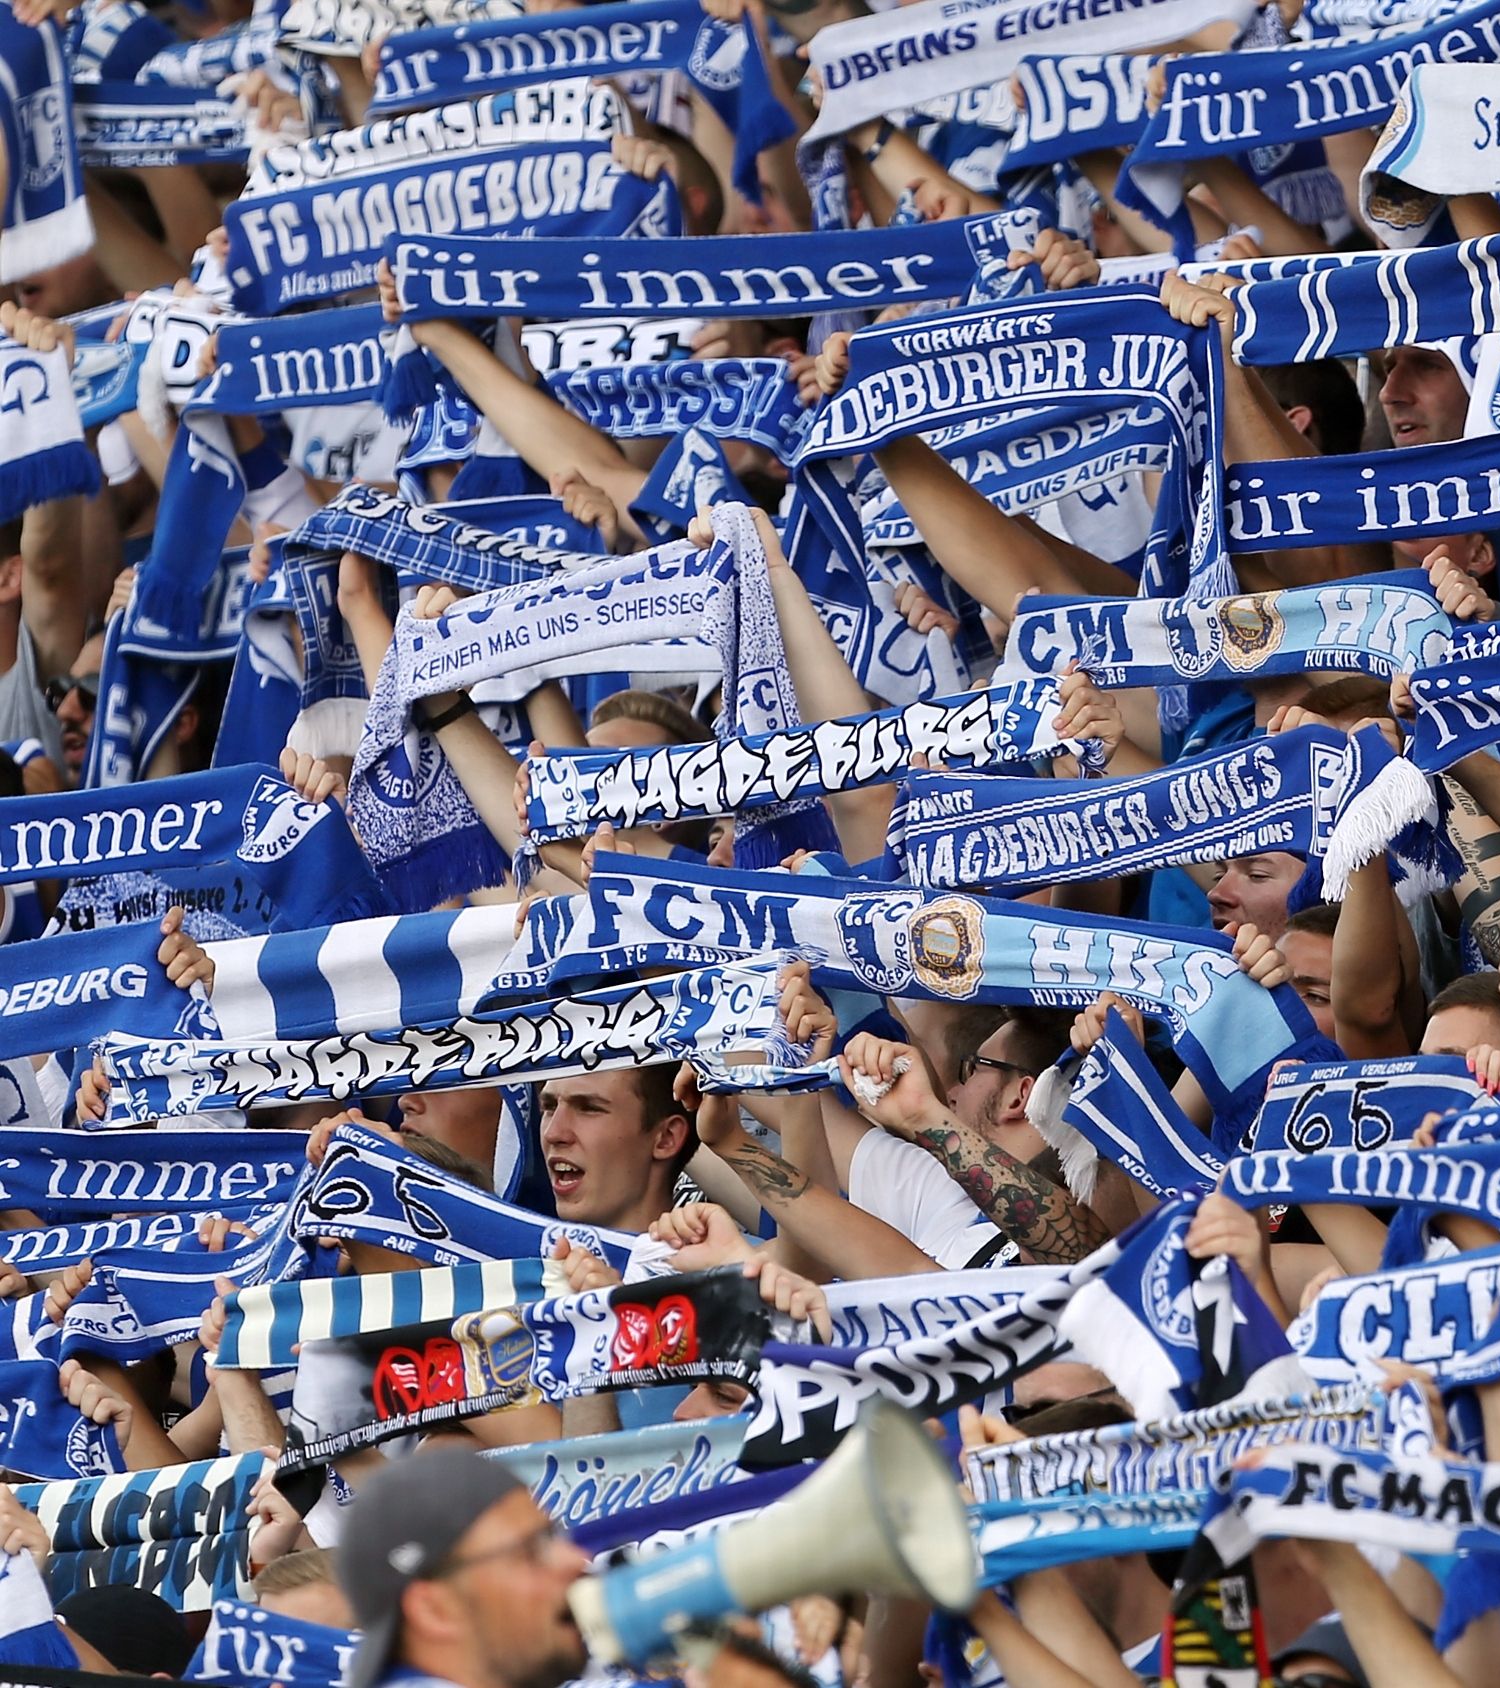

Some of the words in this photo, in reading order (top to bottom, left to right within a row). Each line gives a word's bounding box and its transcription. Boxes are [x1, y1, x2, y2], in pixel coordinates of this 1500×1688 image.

[457, 19, 679, 83] immer
[823, 22, 980, 90] UBFANS
[1154, 70, 1267, 148] für
[240, 202, 308, 276] FC
[311, 150, 630, 259] MAGDEBURG
[391, 242, 541, 311] für
[578, 249, 936, 310] immer
[891, 312, 1056, 357] VORWÄRTS
[250, 335, 383, 403] imm
[820, 337, 1089, 447] DEBURGER
[1072, 446, 1168, 487] AUFH
[1226, 477, 1321, 542] ür
[411, 642, 483, 684] KEINER
[487, 627, 531, 656] MAG
[536, 615, 580, 642] UNS
[596, 586, 720, 627] SCHEISSEG
[1018, 603, 1135, 674] CM
[1303, 649, 1362, 670] HUTNIK
[588, 692, 999, 826] MAGDEBURG
[907, 788, 974, 822] RWÄRTS
[907, 790, 1160, 890] MAGDEBURGER
[1163, 745, 1282, 832] JUNGS
[1258, 820, 1294, 847] UNS
[587, 876, 803, 950] FCM
[625, 945, 648, 967] FC
[665, 942, 762, 965] MAGDE
[1028, 923, 1242, 1017] HKS
[211, 990, 666, 1110] MAGDEBURG
[1310, 1064, 1348, 1081] NICHT
[1360, 1060, 1418, 1077] VERLOREN
[335, 1125, 386, 1150] NICHT
[46, 1146, 295, 1202] immer
[2, 1210, 223, 1264] mmer
[382, 1234, 418, 1254] AUF
[1151, 1231, 1193, 1336] MAGDEB
[1282, 1461, 1358, 1512] FC
[195, 1598, 307, 1684] für
